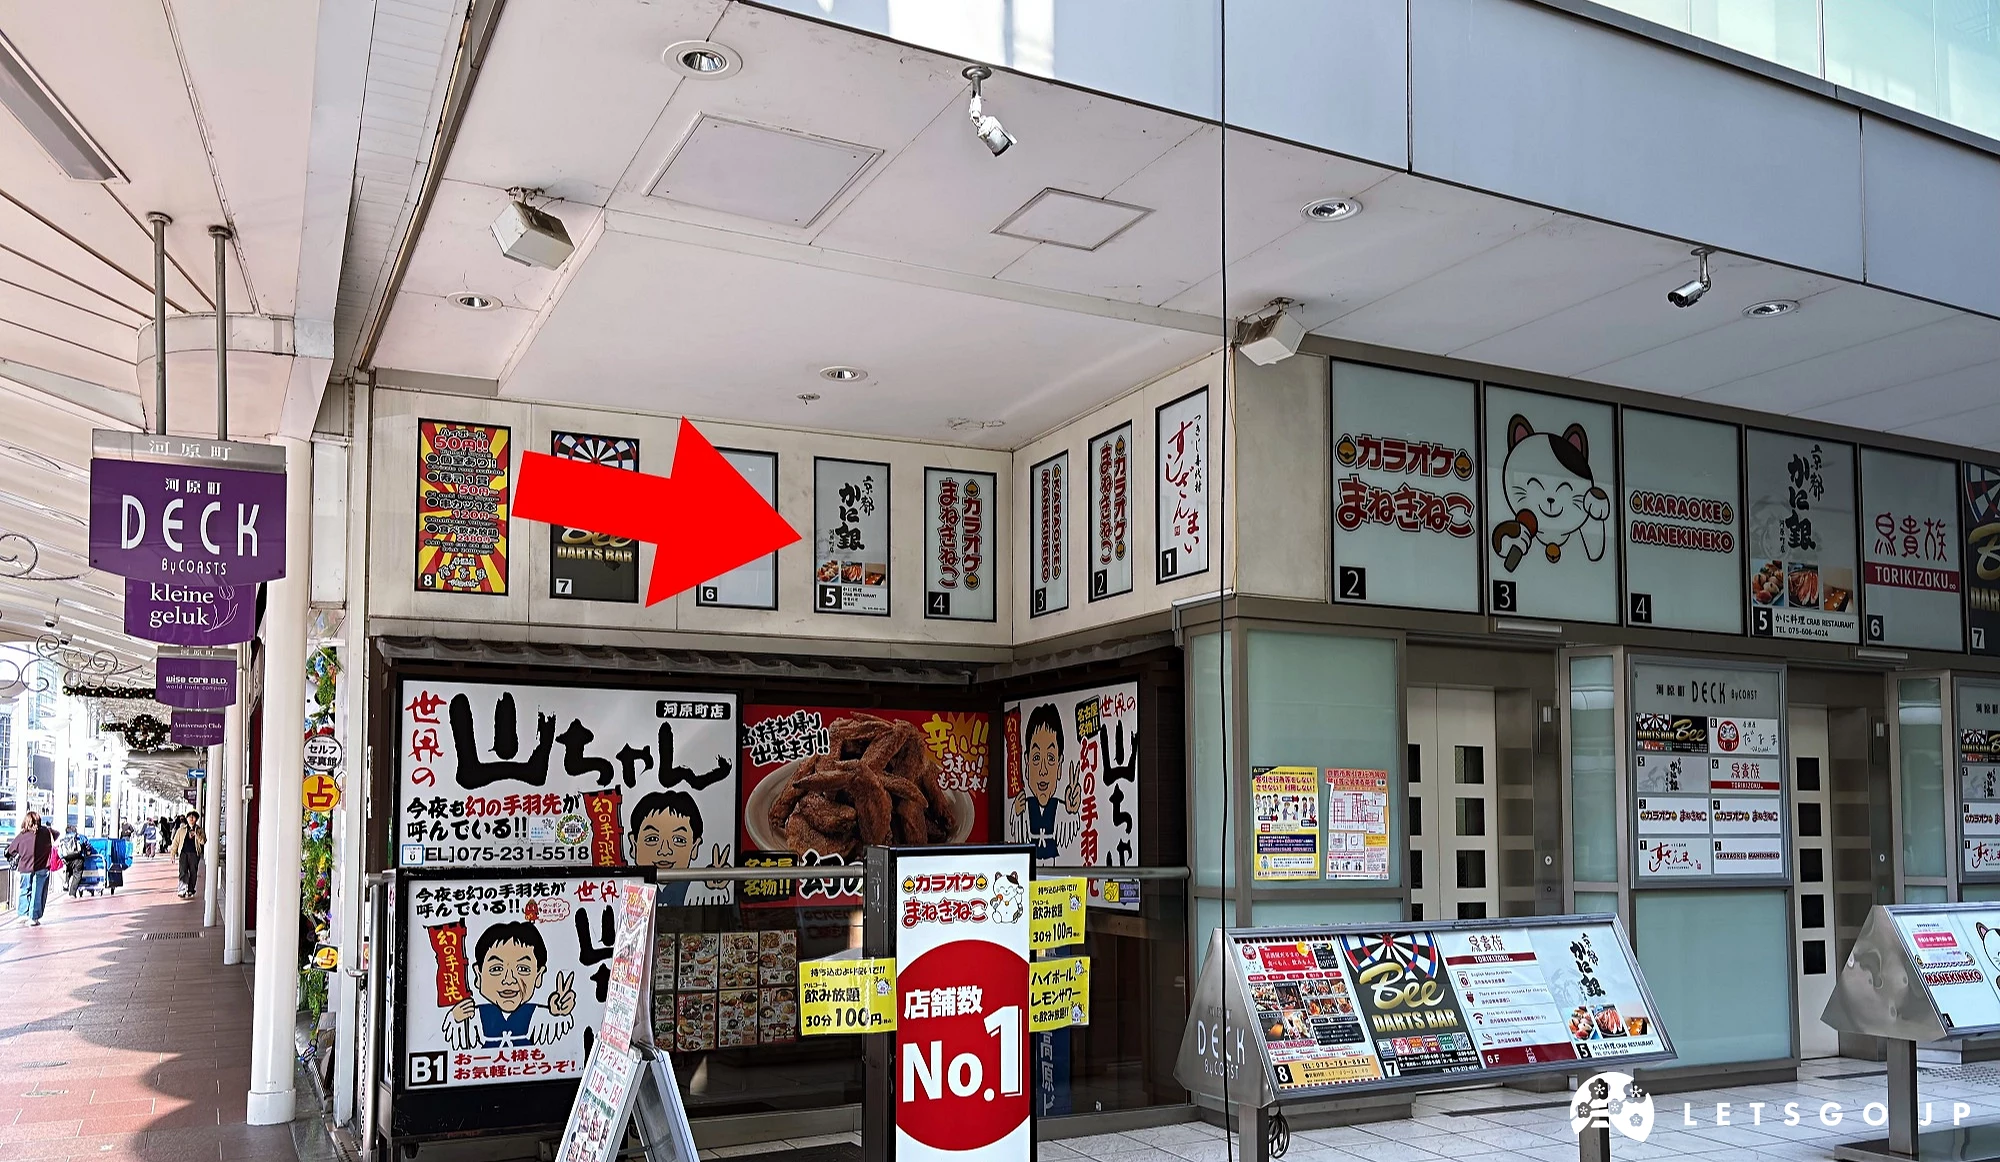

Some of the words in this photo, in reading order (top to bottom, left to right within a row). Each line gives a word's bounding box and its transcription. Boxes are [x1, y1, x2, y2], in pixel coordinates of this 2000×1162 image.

[149, 440, 232, 461] 河原町
[1355, 433, 1456, 478] カラオケ
[1809, 444, 1824, 502] 京都
[165, 477, 222, 496] 河原町
[859, 475, 875, 516] 京都
[1100, 441, 1113, 565] まねきねこ
[1114, 454, 1127, 542] カラオケ
[1336, 473, 1475, 538] まねきねこ
[1641, 491, 1722, 523] KARAOKE
[1785, 453, 1816, 550] かに銀
[121, 494, 260, 557] DECK
[835, 483, 865, 551] かに銀
[1041, 469, 1050, 583] MANEKINEKO
[1052, 477, 1061, 567] KARAOKE
[937, 477, 960, 589] まねきねこ
[962, 497, 982, 573] カラオケ
[1631, 521, 1735, 553] MANEKINEKO
[1875, 512, 1947, 562] 鳥貴族
[557, 546, 603, 560] DARTS
[606, 549, 633, 562] BAR
[1165, 553, 1173, 571] 1
[424, 574, 433, 586] 8
[558, 580, 569, 593] 7
[1097, 573, 1104, 594] 2
[1347, 570, 1360, 596] 2
[1875, 566, 1948, 590] TORIKIZOKU
[150, 583, 214, 604] kleine
[706, 587, 715, 600] 6
[825, 588, 836, 605] 5
[933, 595, 945, 612] 4
[1037, 591, 1044, 610] 3
[1500, 584, 1510, 608] 3
[150, 605, 209, 627] geluk
[1635, 597, 1647, 620] 4
[1759, 611, 1768, 631] 5
[1776, 613, 1805, 626] かに料理
[1822, 619, 1855, 629] RESTAURANT
[1870, 619, 1880, 637] 6
[1973, 630, 1982, 646] 7
[1692, 681, 1726, 705] DECK
[663, 702, 724, 718] 河原町店
[1077, 703, 1099, 722] 名古屋
[1100, 692, 1136, 718] 世界の
[404, 690, 448, 787] 世界の
[742, 710, 821, 748] お持ち帰り
[922, 713, 990, 758] 辛い!!
[1673, 718, 1707, 742] Bee
[308, 744, 337, 754] セルフ
[449, 691, 733, 790] 山ちゃん
[307, 756, 337, 768] 写真館
[1713, 760, 1718, 768] 6
[307, 776, 336, 807] 占
[407, 792, 582, 819] 今夜も幻の手羽先が
[1640, 800, 1645, 808] 3
[1645, 810, 1672, 821] カラオケ
[1719, 810, 1745, 821] カラオケ
[407, 817, 527, 842] 呼んでいる!!
[424, 846, 589, 862] EL]075-231-5518
[1715, 842, 1720, 850] 2
[415, 881, 567, 903] 今夜も幻の手羽先が
[915, 873, 976, 891] カラオケ
[416, 899, 521, 918] 呼んでいる!!
[902, 898, 988, 928] まねきねこ
[1033, 904, 1063, 920] 飲み放題
[319, 949, 336, 966] 占
[436, 929, 463, 1002] 幻の手羽先
[1359, 962, 1445, 1010] Bee
[1923, 969, 1983, 986] MANEKINEKO
[804, 987, 861, 1004] 飲み放題
[904, 985, 984, 1020] 店舗数
[1031, 987, 1081, 1006] レモンサワー
[1371, 1011, 1426, 1033] DARTS
[1425, 1008, 1458, 1029] BAR
[454, 1049, 546, 1066] お一人様も
[903, 1005, 1023, 1103] No.1
[1487, 1054, 1500, 1064] 6F
[1580, 1045, 1589, 1057] 5
[411, 1055, 445, 1083] B1
[454, 1061, 576, 1080] お気軽にどうぞ!
[1277, 1066, 1289, 1082] 8
[1386, 1061, 1395, 1076] 7
